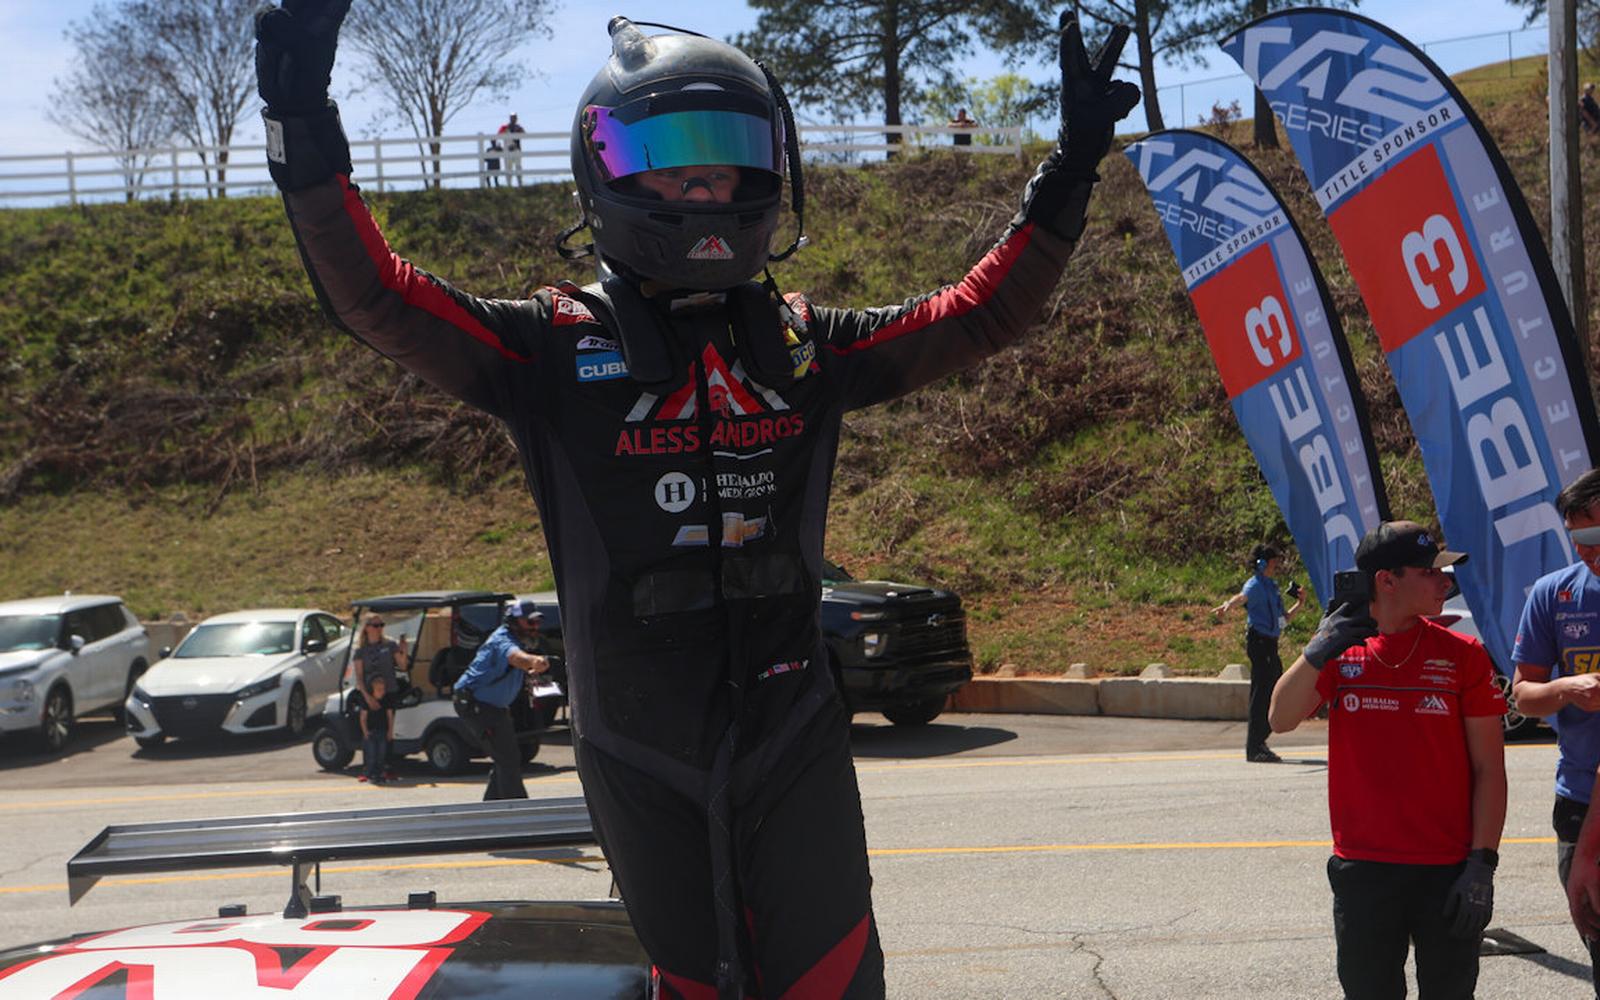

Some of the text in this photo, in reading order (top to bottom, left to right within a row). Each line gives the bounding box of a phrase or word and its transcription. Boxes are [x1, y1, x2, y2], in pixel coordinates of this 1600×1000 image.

[1270, 101, 1384, 150] SERIES
[1325, 108, 1451, 200] TITLE SPONSOR
[1153, 200, 1234, 243] SERIES
[1189, 215, 1281, 280] TITLE SPONSOR
[1401, 214, 1469, 310] 3
[1245, 295, 1292, 368] 3
